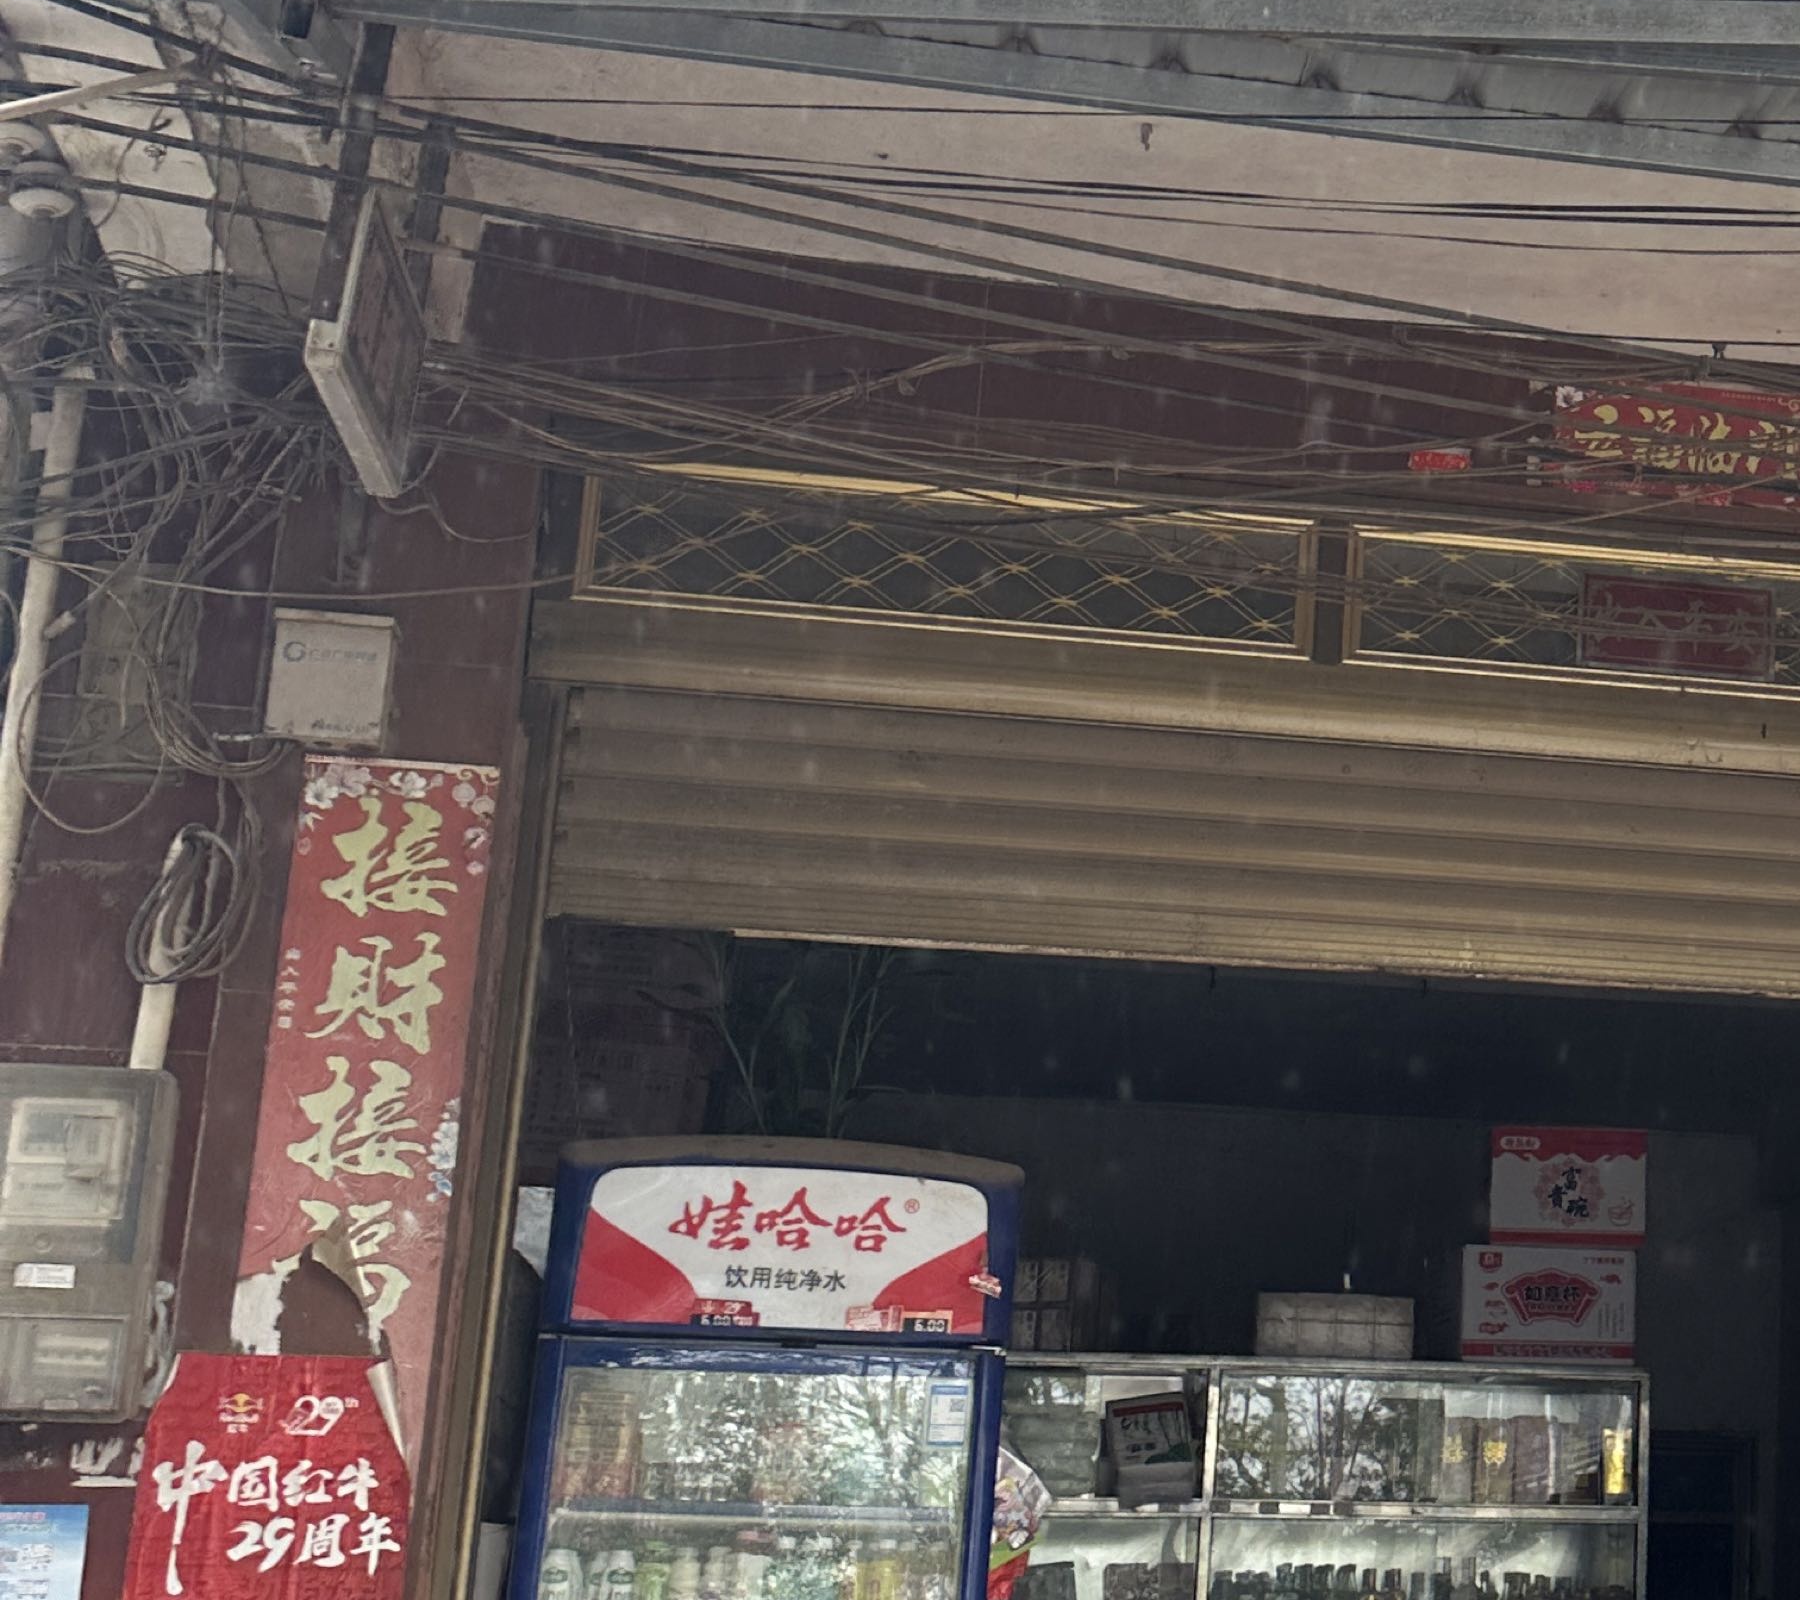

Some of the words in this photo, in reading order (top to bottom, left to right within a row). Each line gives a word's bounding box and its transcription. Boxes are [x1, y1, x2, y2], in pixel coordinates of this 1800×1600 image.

[667, 1180, 907, 1253] 娃哈哈
[724, 1264, 847, 1292] 饮用纯净水
[153, 1440, 379, 1595] 中国红牛
[226, 1512, 401, 1577] 29周年
